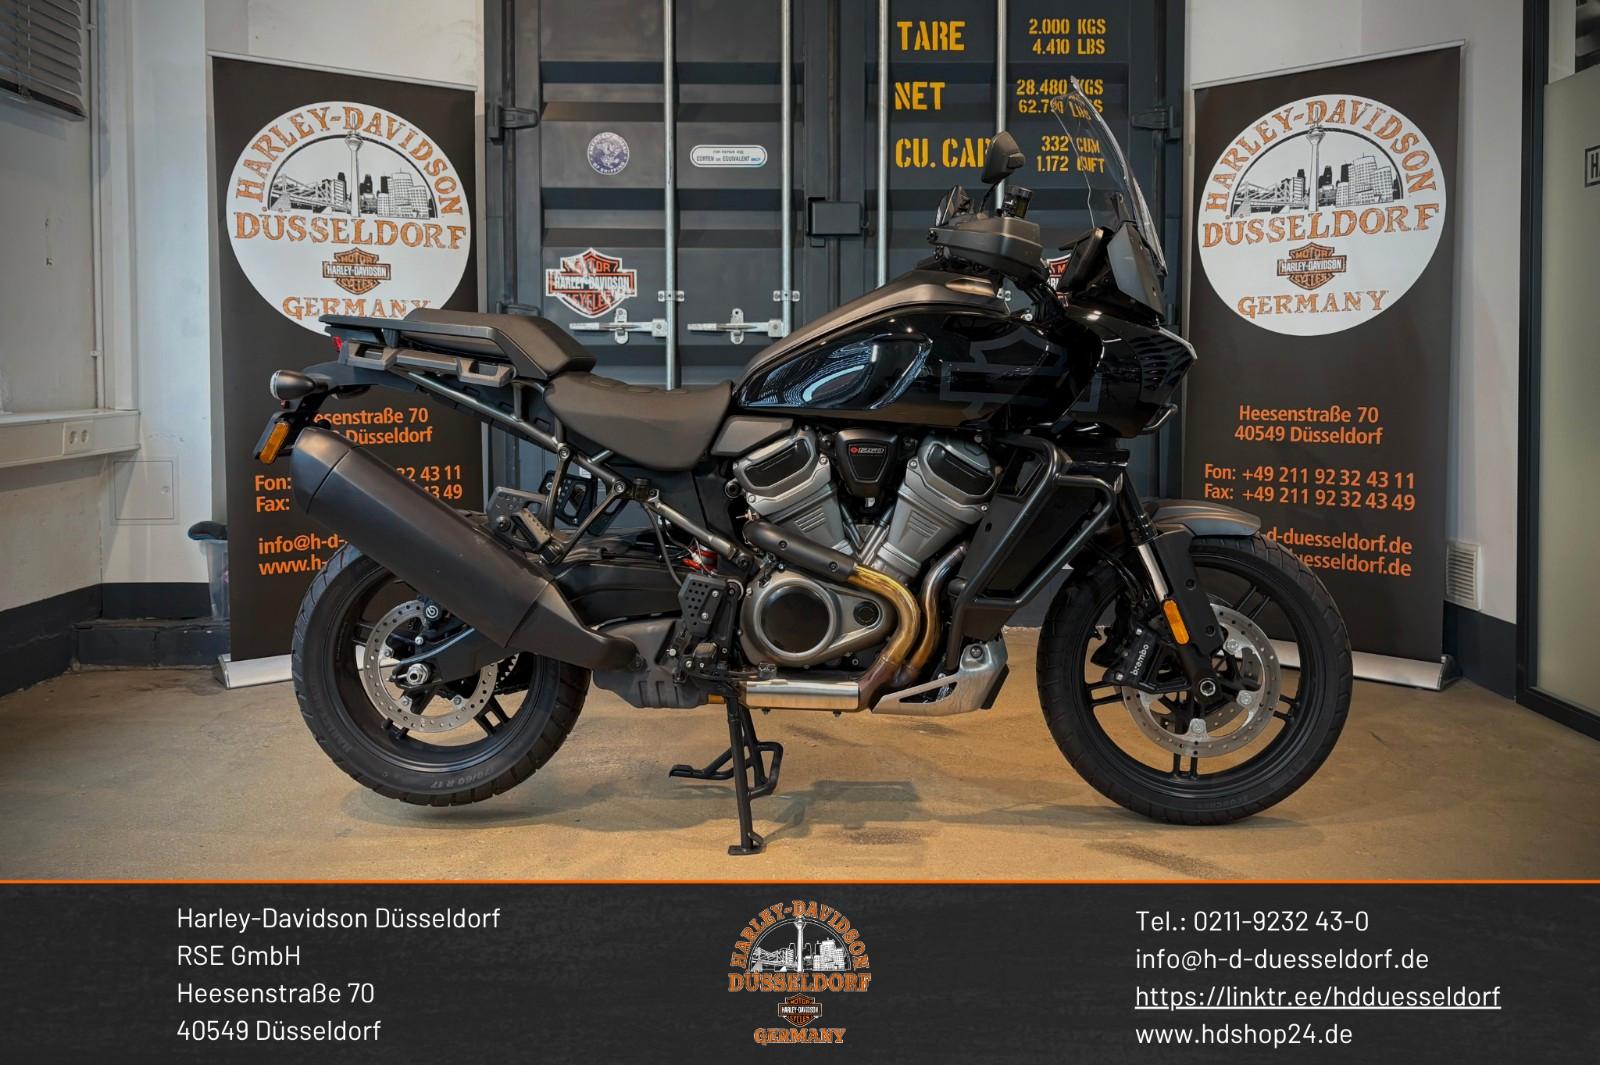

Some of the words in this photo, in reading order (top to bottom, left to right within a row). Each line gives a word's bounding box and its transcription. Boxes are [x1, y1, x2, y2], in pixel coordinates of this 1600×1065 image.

[897, 21, 965, 50] TARE
[1028, 19, 1069, 34] 2.000
[1077, 18, 1106, 34] KGS
[1032, 39, 1070, 54] 4.410
[1077, 38, 1106, 54] LBS
[894, 82, 945, 110] NET
[1016, 79, 1068, 95] 28.480
[1041, 135, 1069, 152] 332
[1205, 99, 1437, 213] HARLEY-DAVIDSON
[235, 106, 463, 216] HARLEY-DAVIDSON
[1036, 155, 1069, 172] 1.172
[234, 206, 467, 249] DÜSSELDORF
[1203, 203, 1439, 248] DÜSSELDORF
[1281, 259, 1342, 273] HARLEY-DAVIDSON
[1294, 248, 1329, 259] MOTOR
[327, 264, 386, 277] HARLEY-DAVIDSON
[555, 276, 629, 289] HARLEY-DAVIDSON
[1237, 289, 1389, 319] GERMANY
[313, 408, 404, 425] esenstraße
[408, 407, 428, 423] 70
[1239, 405, 1351, 423] Heesenstraße
[1357, 406, 1379, 424] 70
[1234, 425, 1285, 442] 40549
[1290, 427, 1383, 444] Düsseldorf
[255, 475, 292, 491] Fon:
[420, 466, 440, 481] 43
[444, 464, 462, 481] 11
[1204, 463, 1236, 480] Fon:
[1242, 466, 1274, 481] +49
[1279, 467, 1308, 484] 211
[1315, 469, 1336, 485] 92
[1340, 470, 1361, 487] 32
[1366, 471, 1389, 488] 43
[1394, 472, 1415, 489] 11
[256, 497, 290, 512] Fax:
[443, 484, 463, 499] 49
[1204, 483, 1234, 499] Fax:
[1242, 486, 1274, 502] +49
[1280, 488, 1308, 504] 211
[1315, 490, 1336, 506] 92
[1340, 491, 1361, 508] 32
[1365, 493, 1388, 509] 43
[1391, 494, 1415, 511] 49
[1130, 644, 1149, 676] brembo
